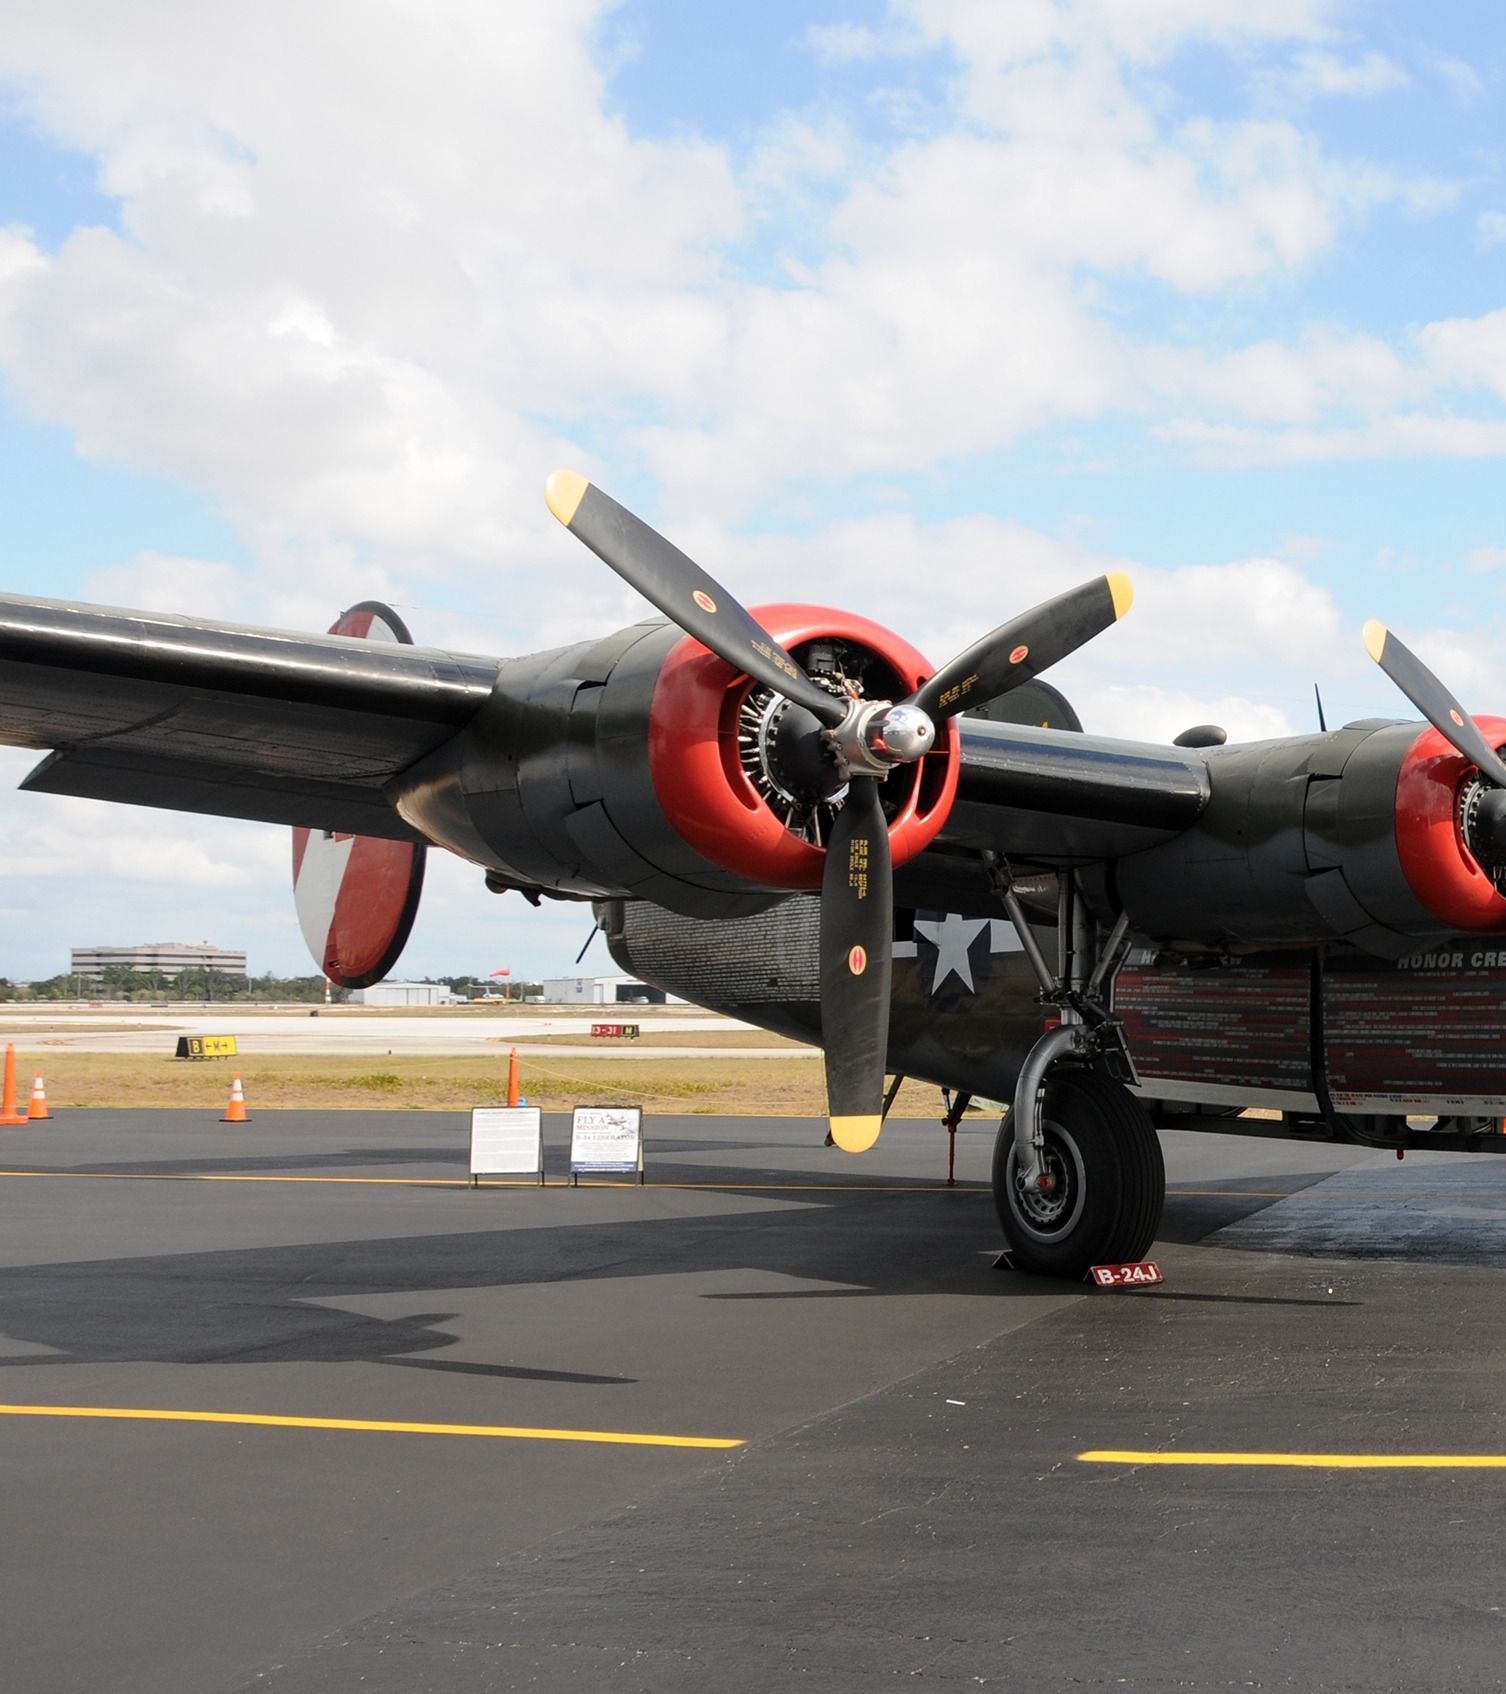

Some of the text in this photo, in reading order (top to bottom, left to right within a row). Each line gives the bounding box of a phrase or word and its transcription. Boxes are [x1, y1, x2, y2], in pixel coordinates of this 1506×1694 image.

[1398, 953, 1464, 968] HONOR
[192, 1040, 200, 1053] B
[577, 1116, 596, 1124] FLY
[1097, 1266, 1157, 1284] B-24J
